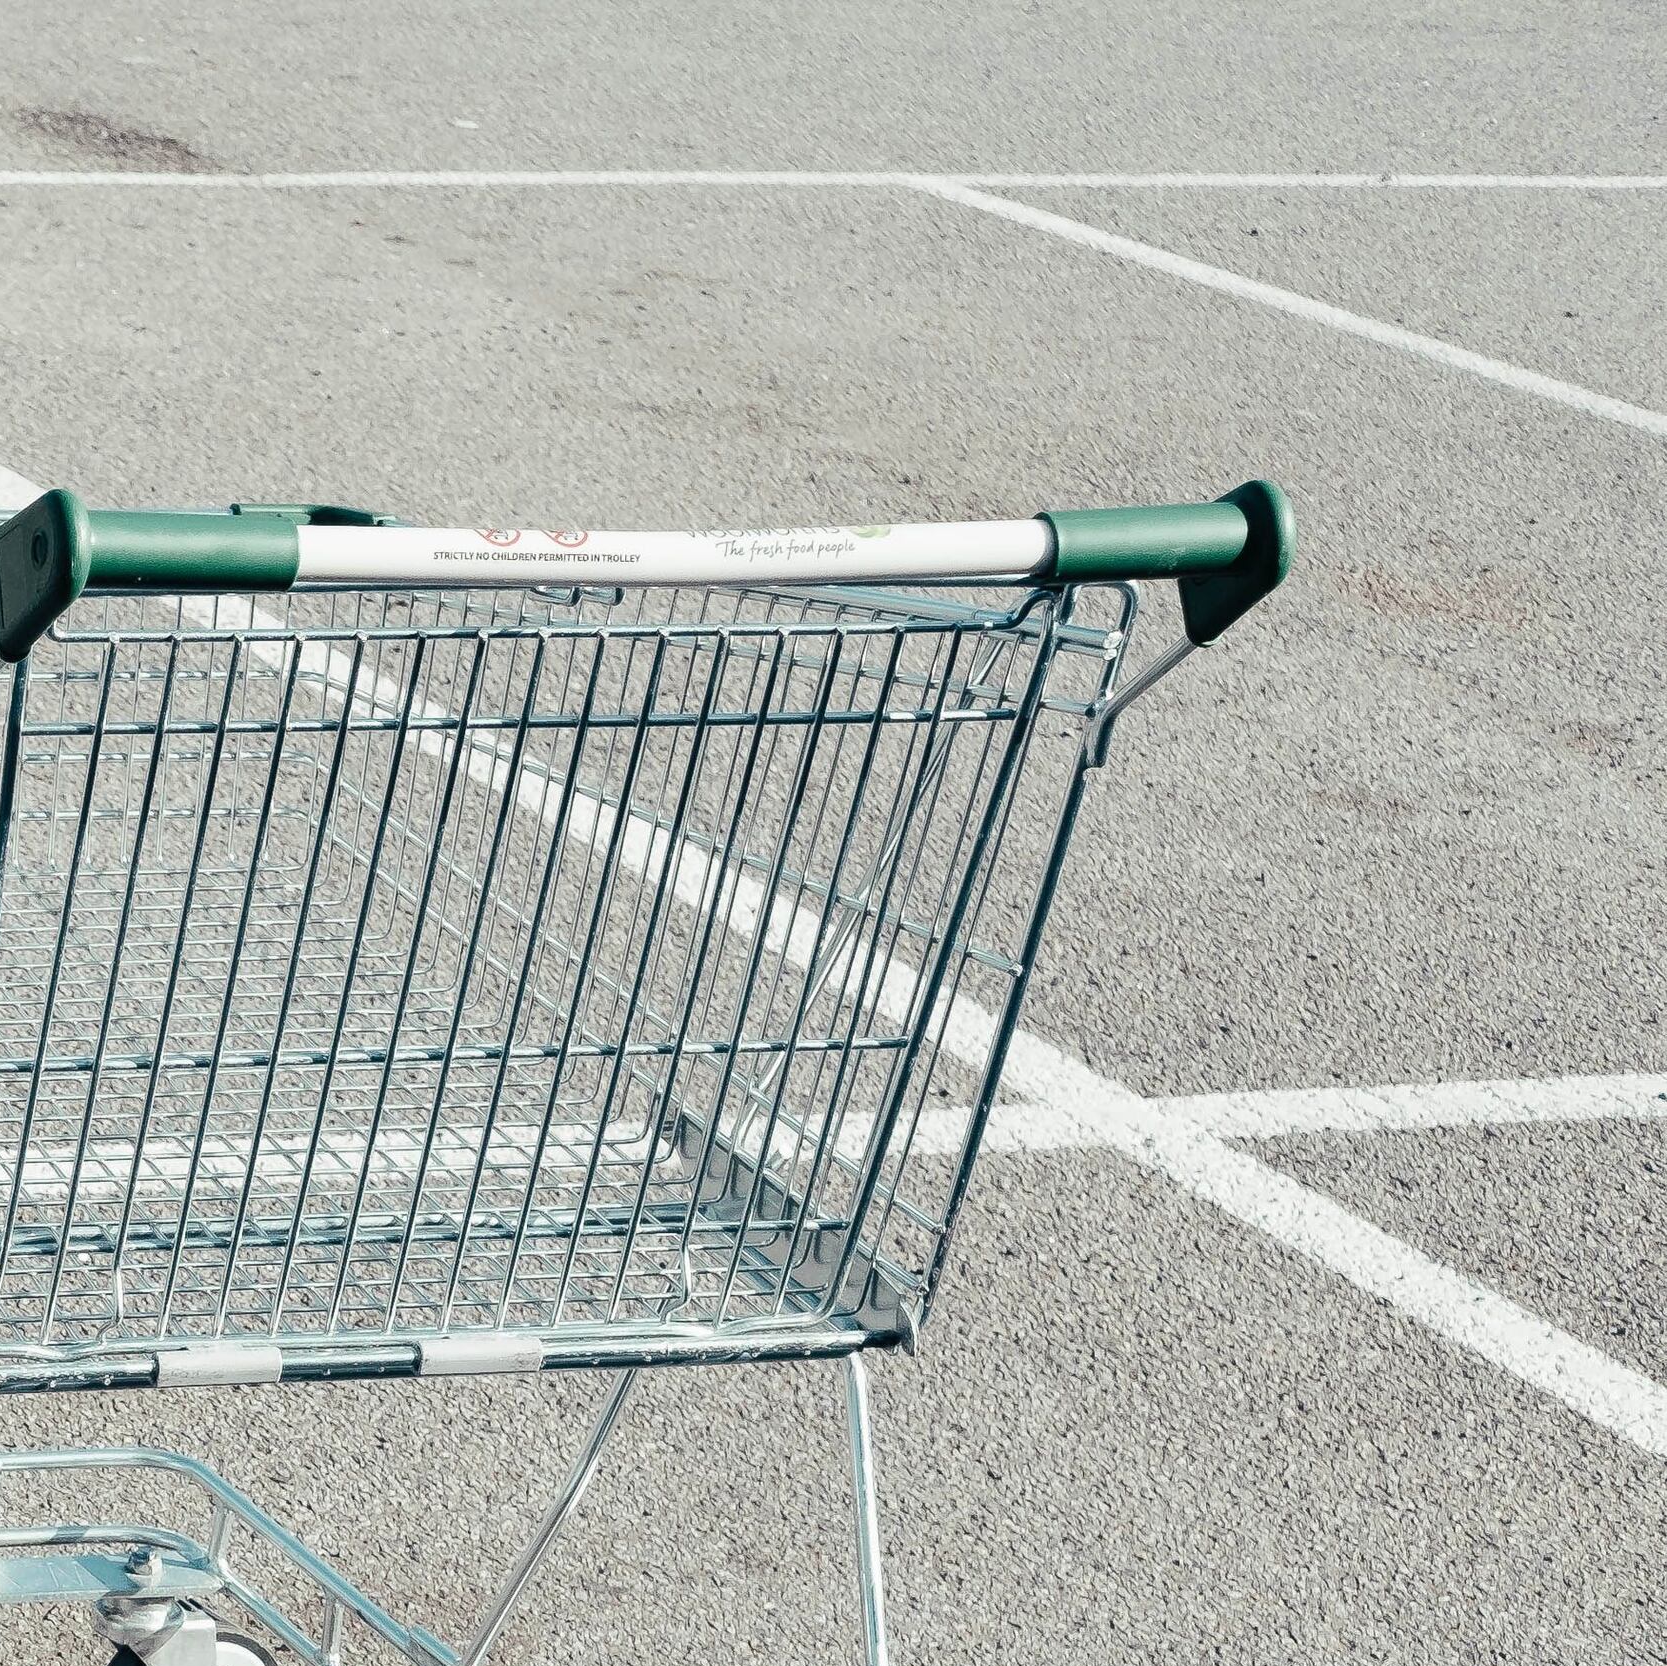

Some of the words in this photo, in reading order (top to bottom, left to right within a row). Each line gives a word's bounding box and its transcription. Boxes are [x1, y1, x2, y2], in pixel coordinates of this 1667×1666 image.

[433, 551, 474, 560] STRICTLY
[476, 552, 490, 560] NO
[491, 552, 537, 561] CHILDREN
[538, 553, 589, 562] PERMITTED
[590, 554, 600, 562] IN
[602, 554, 641, 563] TROLLEY
[716, 540, 745, 557] The
[749, 541, 784, 562] fresh
[786, 539, 814, 560] food
[817, 539, 855, 558] people
